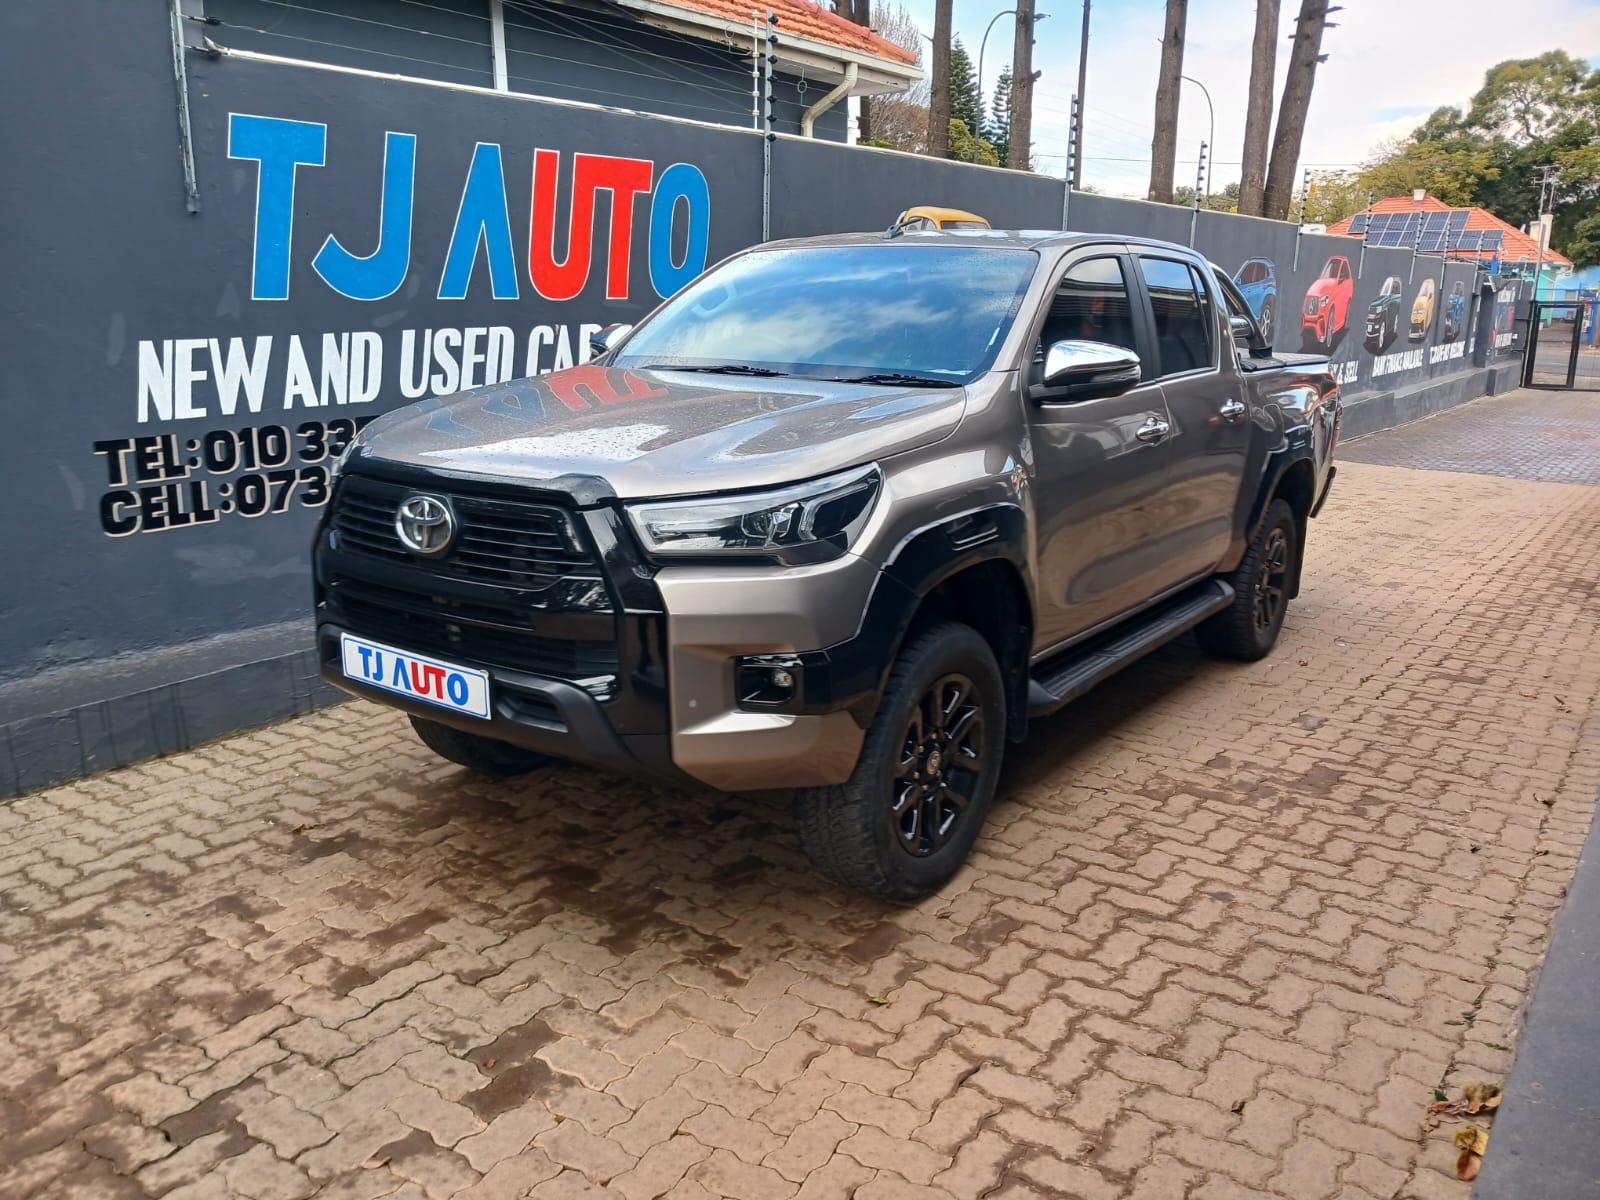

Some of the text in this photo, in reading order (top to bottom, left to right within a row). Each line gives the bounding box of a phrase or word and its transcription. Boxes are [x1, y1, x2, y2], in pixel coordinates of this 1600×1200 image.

[227, 112, 710, 300] TJ AUTO
[138, 335, 273, 423] NEW
[283, 331, 382, 410] AND
[400, 325, 515, 399] USED
[358, 646, 469, 706] TJ AUTO
